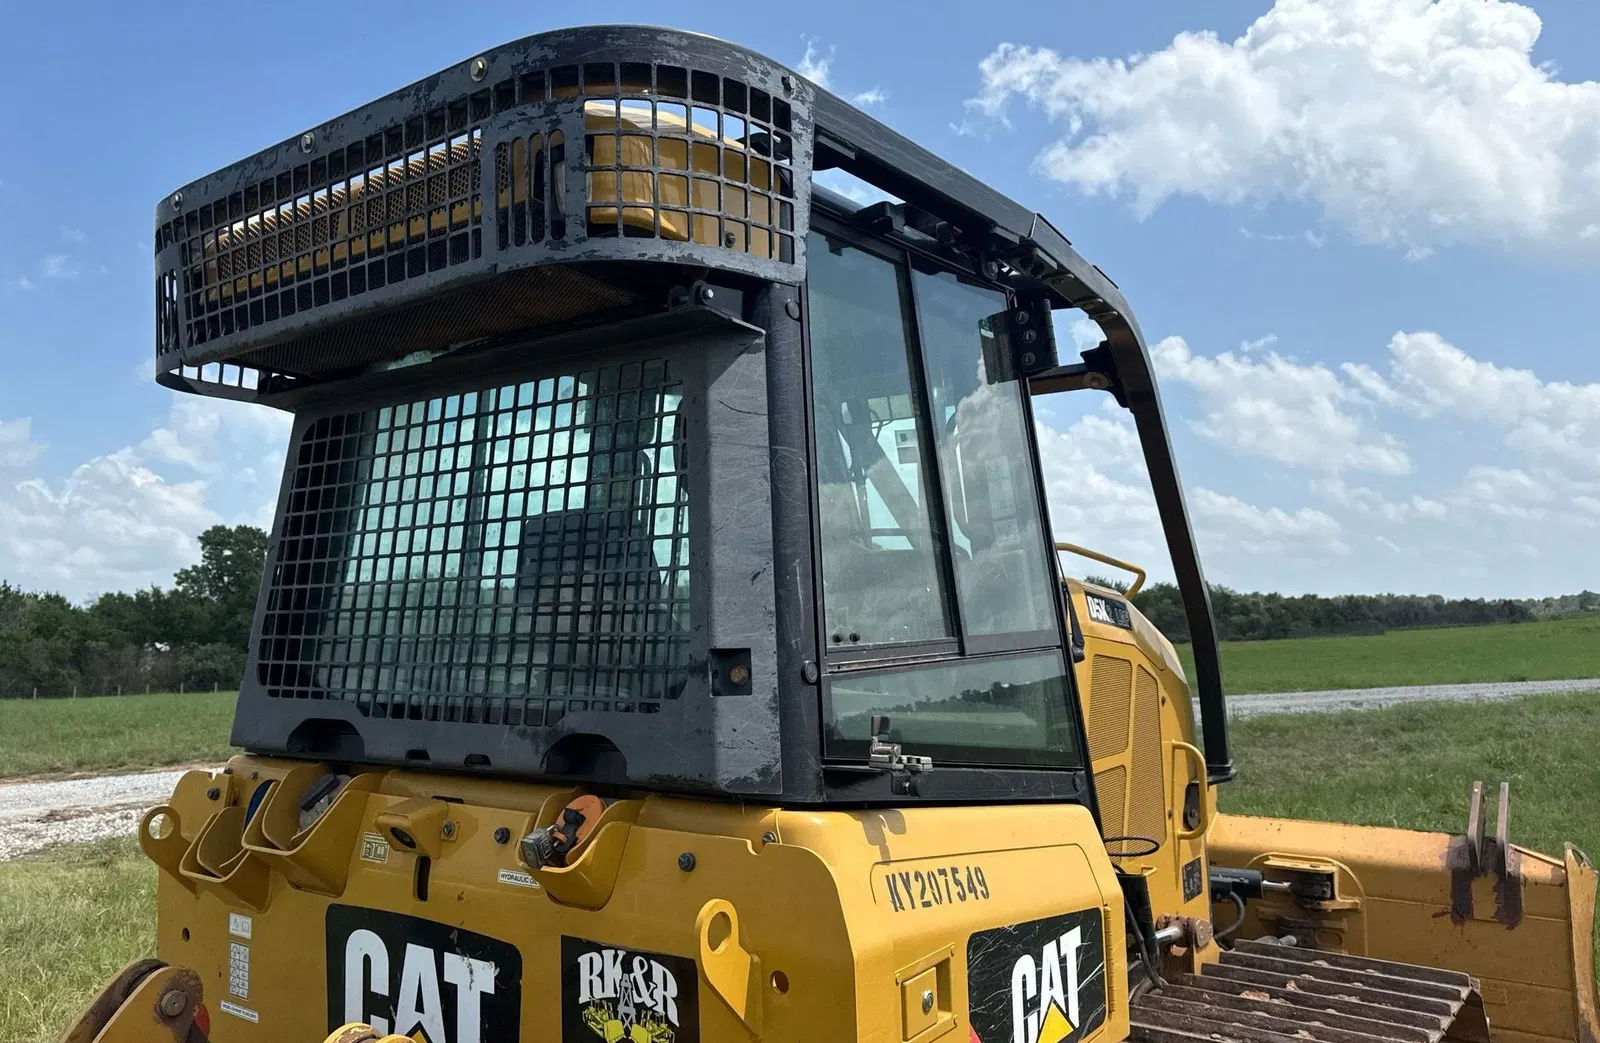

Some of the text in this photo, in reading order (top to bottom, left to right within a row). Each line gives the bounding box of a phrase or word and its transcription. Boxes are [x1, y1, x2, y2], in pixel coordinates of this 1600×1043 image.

[500, 872, 529, 883] HYDRAULIC
[885, 865, 990, 912] KY207549
[344, 928, 496, 1043] CAT
[577, 949, 680, 1028] RK&R
[1011, 925, 1082, 1043] CAT
